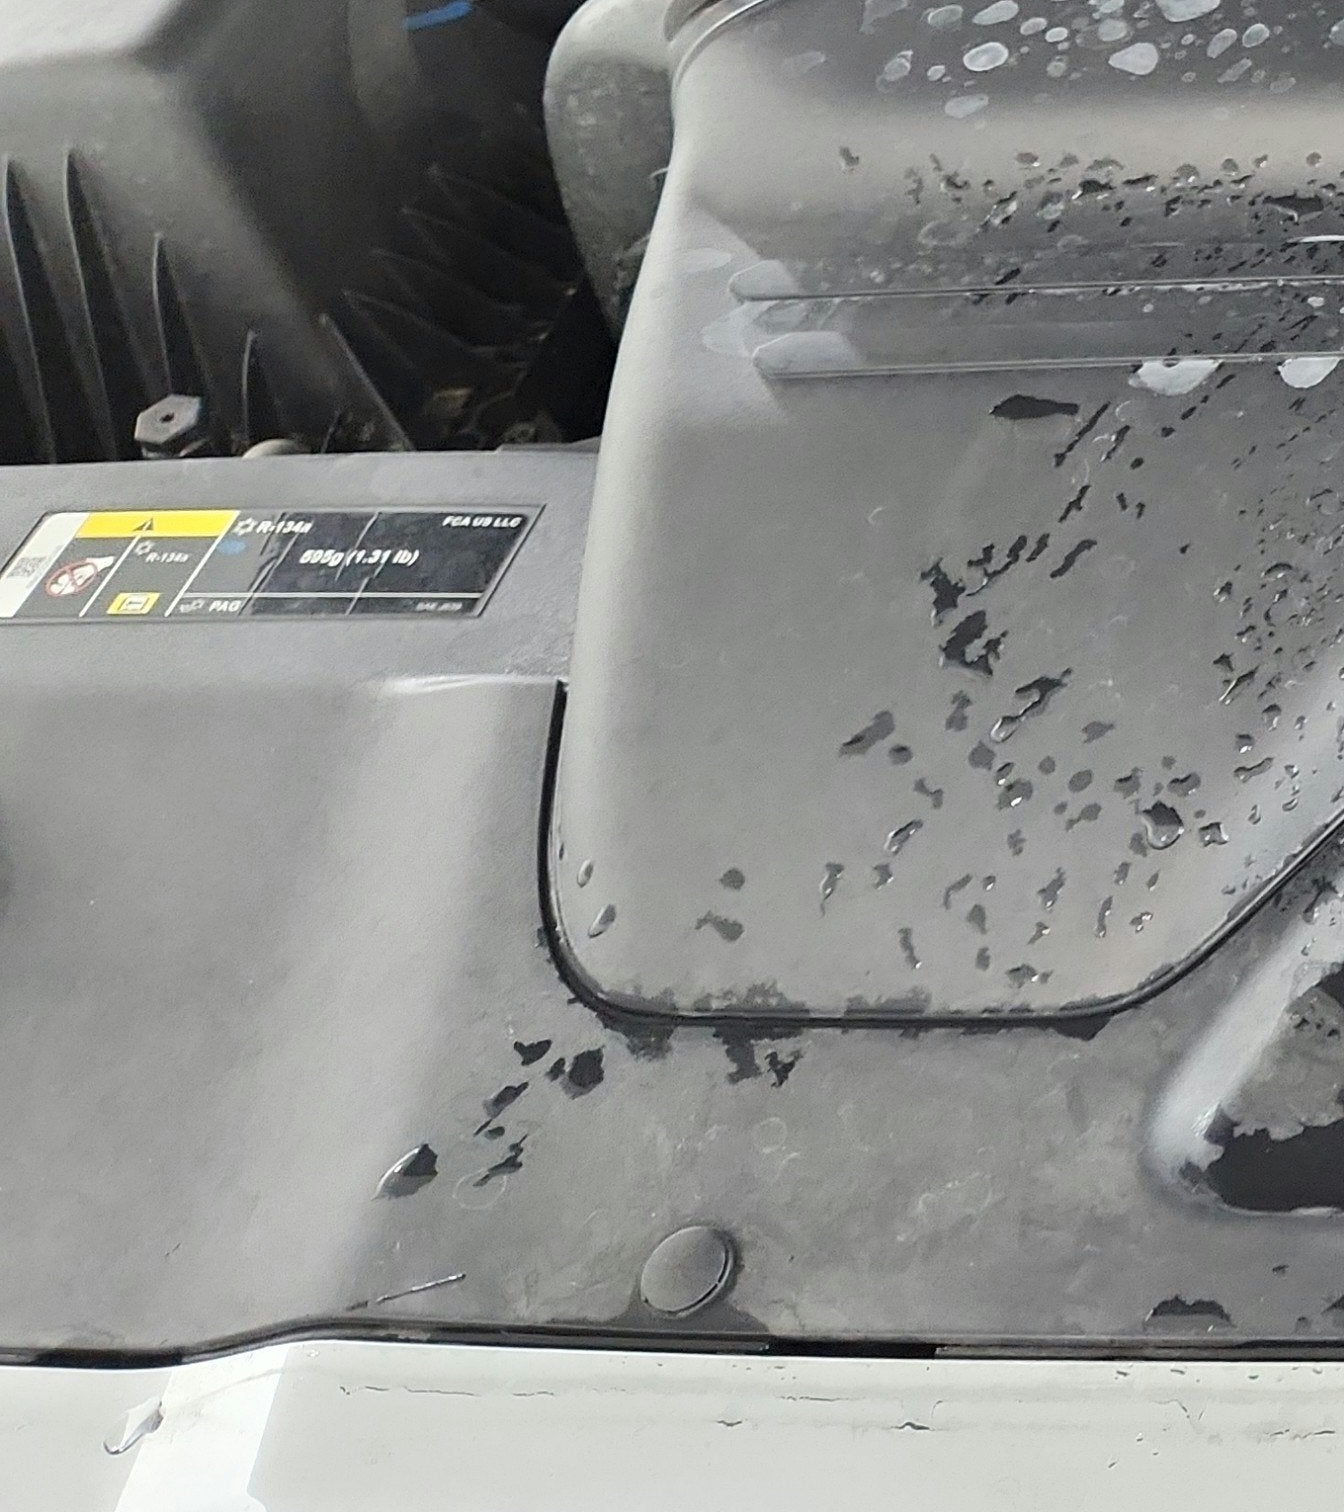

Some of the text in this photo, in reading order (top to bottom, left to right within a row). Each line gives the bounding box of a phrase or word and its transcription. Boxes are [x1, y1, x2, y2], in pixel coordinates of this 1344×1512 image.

[255, 520, 313, 534] R-134a
[442, 515, 471, 528] FCA
[391, 548, 420, 567] lb)
